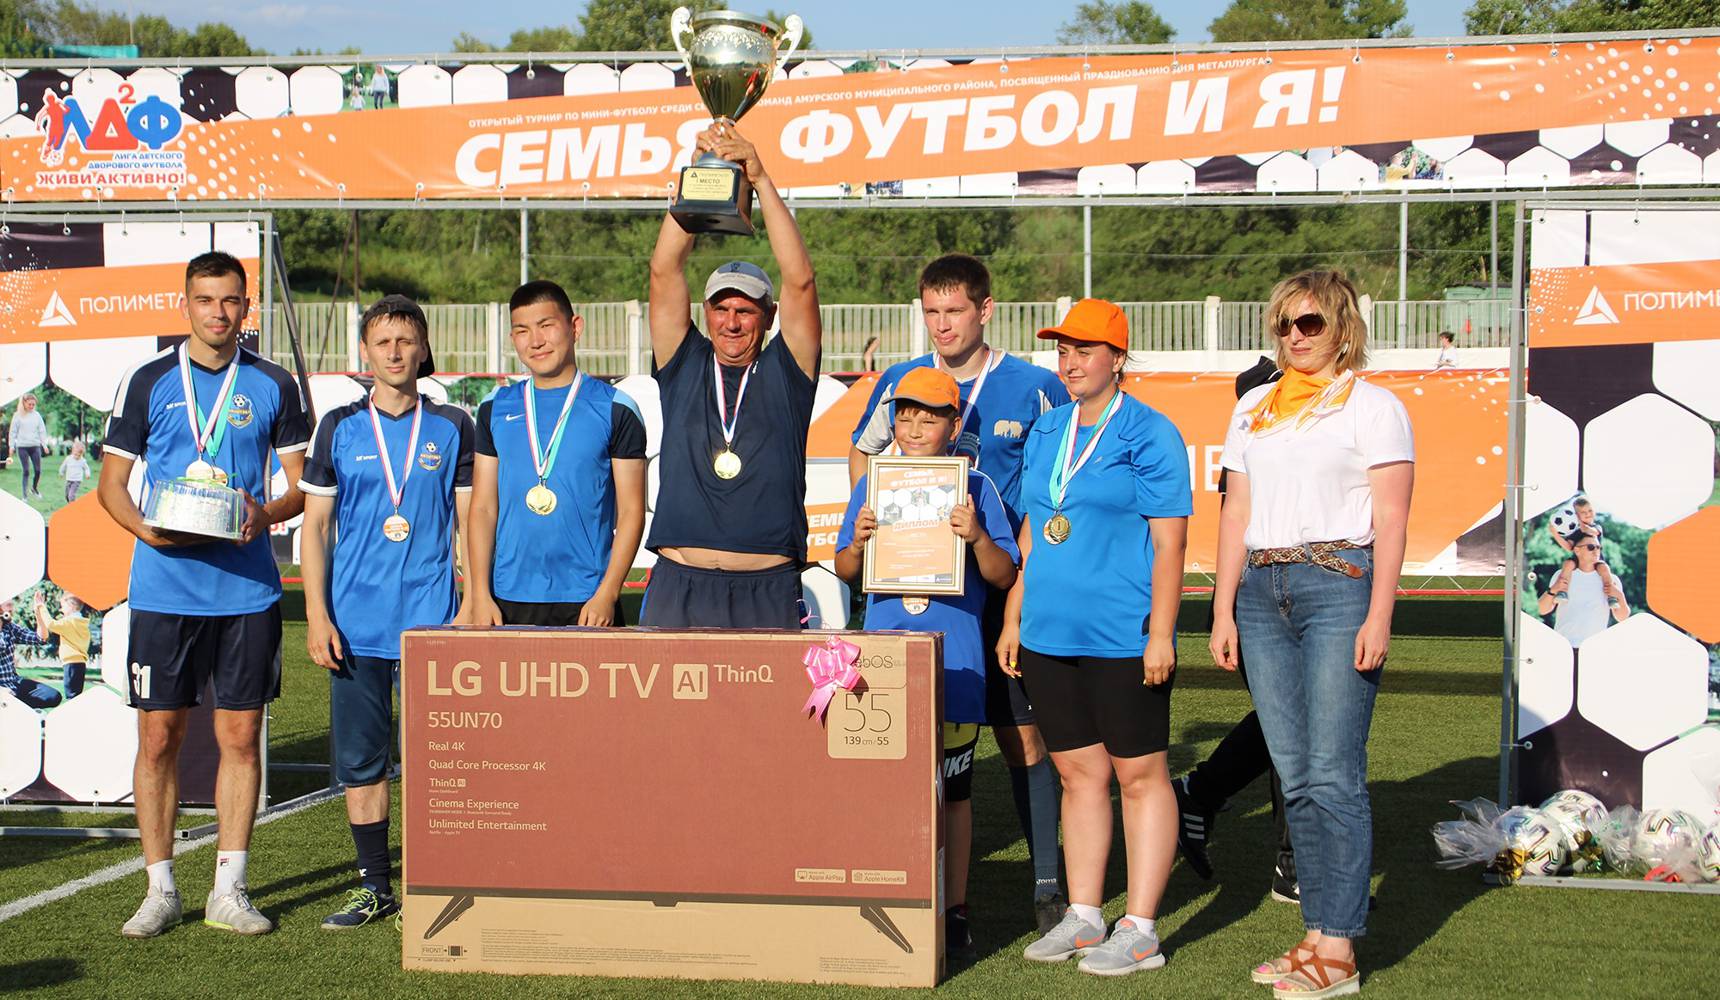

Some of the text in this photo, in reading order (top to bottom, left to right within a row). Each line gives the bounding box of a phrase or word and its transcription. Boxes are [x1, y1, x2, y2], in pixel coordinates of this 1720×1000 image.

[468, 115, 523, 128] ОТКРЫТЫЙ
[526, 113, 562, 124] ТУРНИР
[565, 111, 579, 121] ПО
[581, 106, 658, 119] МИНИ-ФУТБОЛУ
[660, 103, 692, 114] СРЕДИ
[757, 95, 793, 107] ОМАНД
[795, 91, 853, 104] АМУРСКОГО
[855, 83, 951, 99] МУНИЦИПАЛЬНОГО
[954, 79, 998, 92] РАЙОНА,
[1000, 71, 1081, 88] ПОСВЯЩЕННЫЙ
[1084, 66, 1170, 81] ПРАЗДНОВАНИЮ
[1197, 57, 1265, 71] МЕТАЛЛУРГА
[779, 84, 1139, 165] ФУТБОЛ
[1163, 76, 1230, 137] И
[1252, 65, 1347, 129] Я!
[88, 162, 140, 170] ДВОРОВОГО
[38, 172, 185, 185] ЖИВИ АКТИВНО!
[855, 655, 893, 669] ebOS
[427, 660, 774, 699] LG UHD TV AI ThinQ
[843, 693, 892, 733] 55
[427, 711, 503, 729] 55UN70
[428, 741, 465, 751] Real 4K
[844, 736, 861, 745] 139
[877, 736, 889, 745] 55
[428, 759, 546, 771] Quad Core Processor 4K
[944, 749, 973, 778] IKE
[429, 777, 457, 788] ThinQ
[428, 798, 520, 810] Cinema Experience
[428, 818, 548, 831] Unlimited Entertainment
